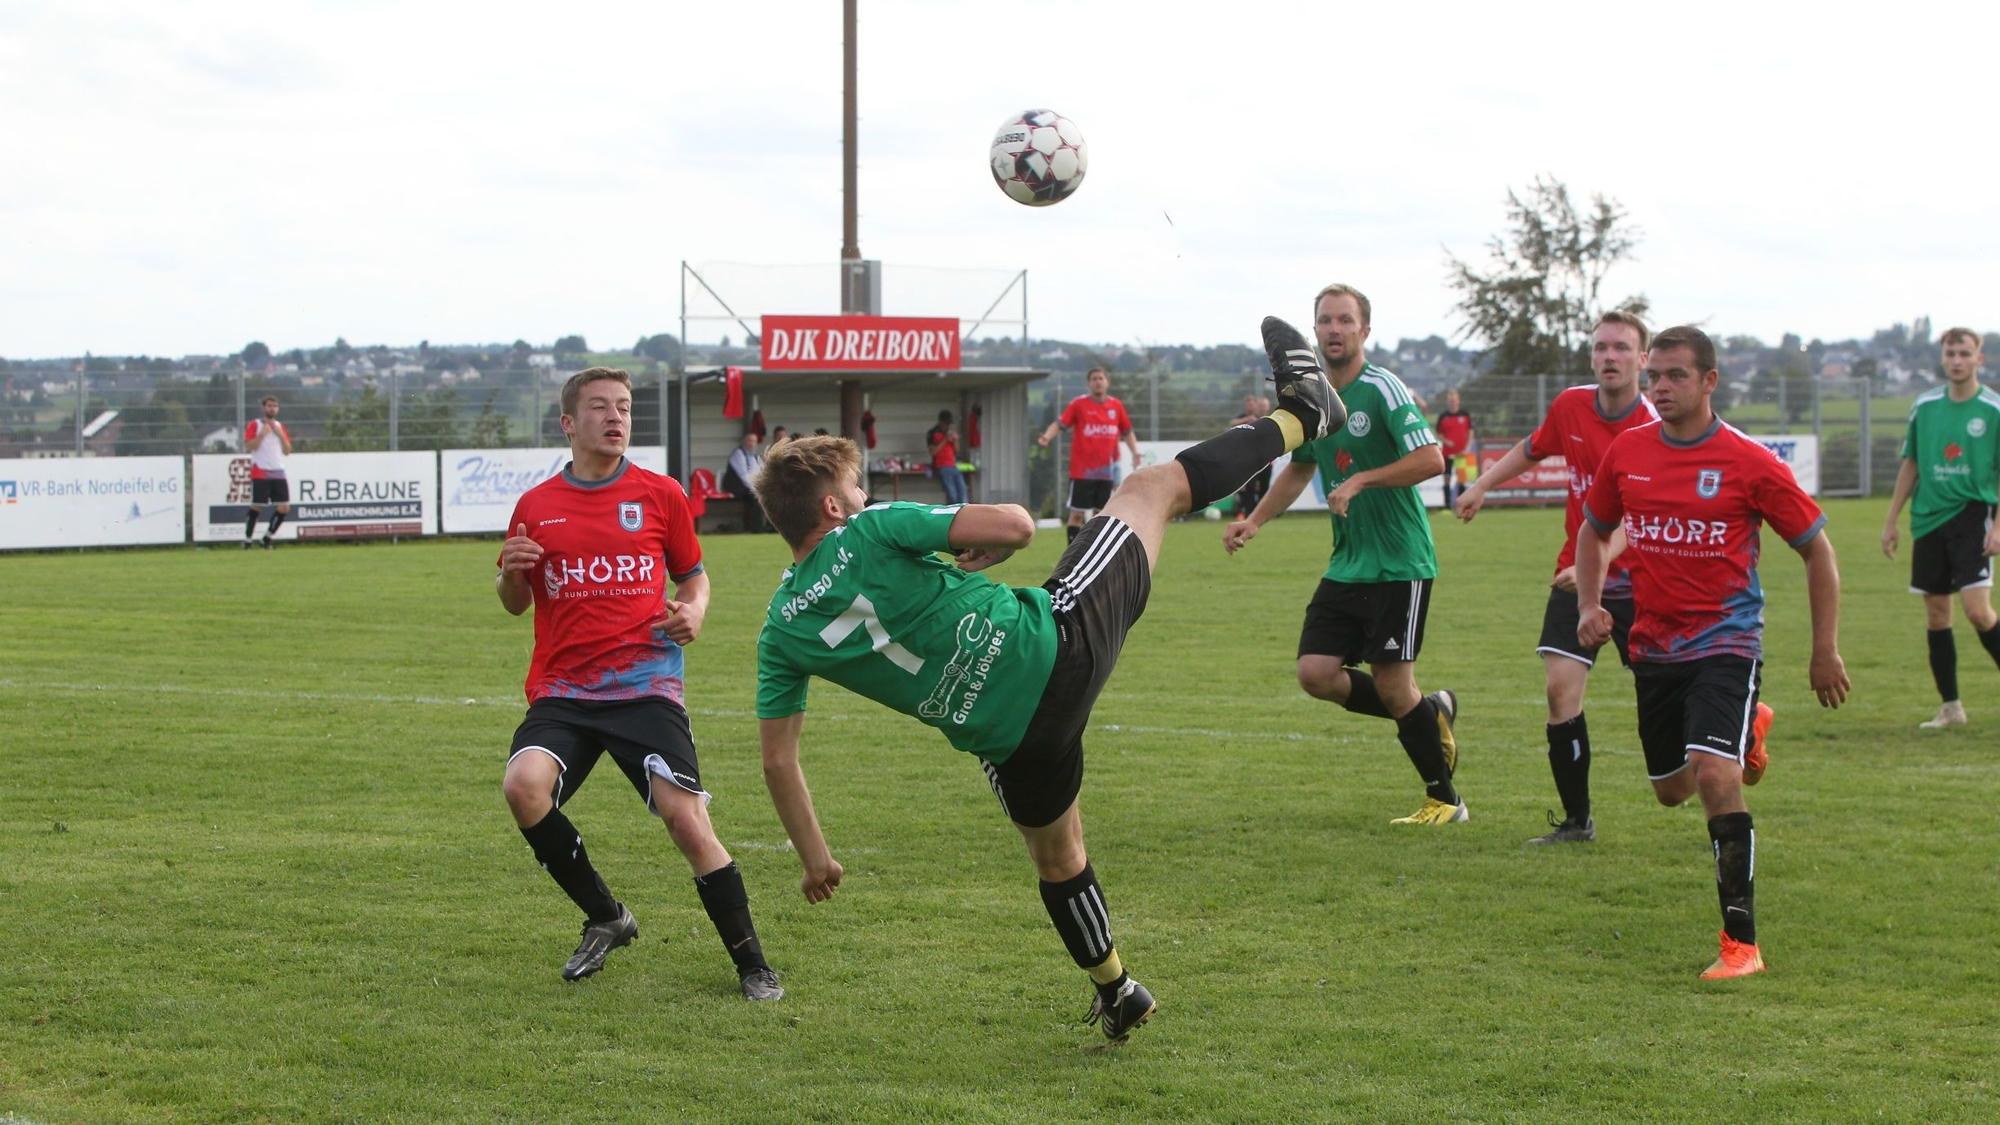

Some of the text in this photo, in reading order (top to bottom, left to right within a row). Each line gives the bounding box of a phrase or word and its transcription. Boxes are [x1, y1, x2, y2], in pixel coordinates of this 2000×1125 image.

[769, 329, 954, 361] DJK DREIBORN
[21, 477, 177, 496] VR-Bank Nordeifel eG
[832, 546, 853, 577] e.V.
[1641, 545, 1727, 558] RUND UM EDELSTAHL
[564, 588, 655, 598] RUND UM EDELSTAHL
[818, 593, 925, 675] 7
[953, 629, 1006, 724] Groß & Jöbges
